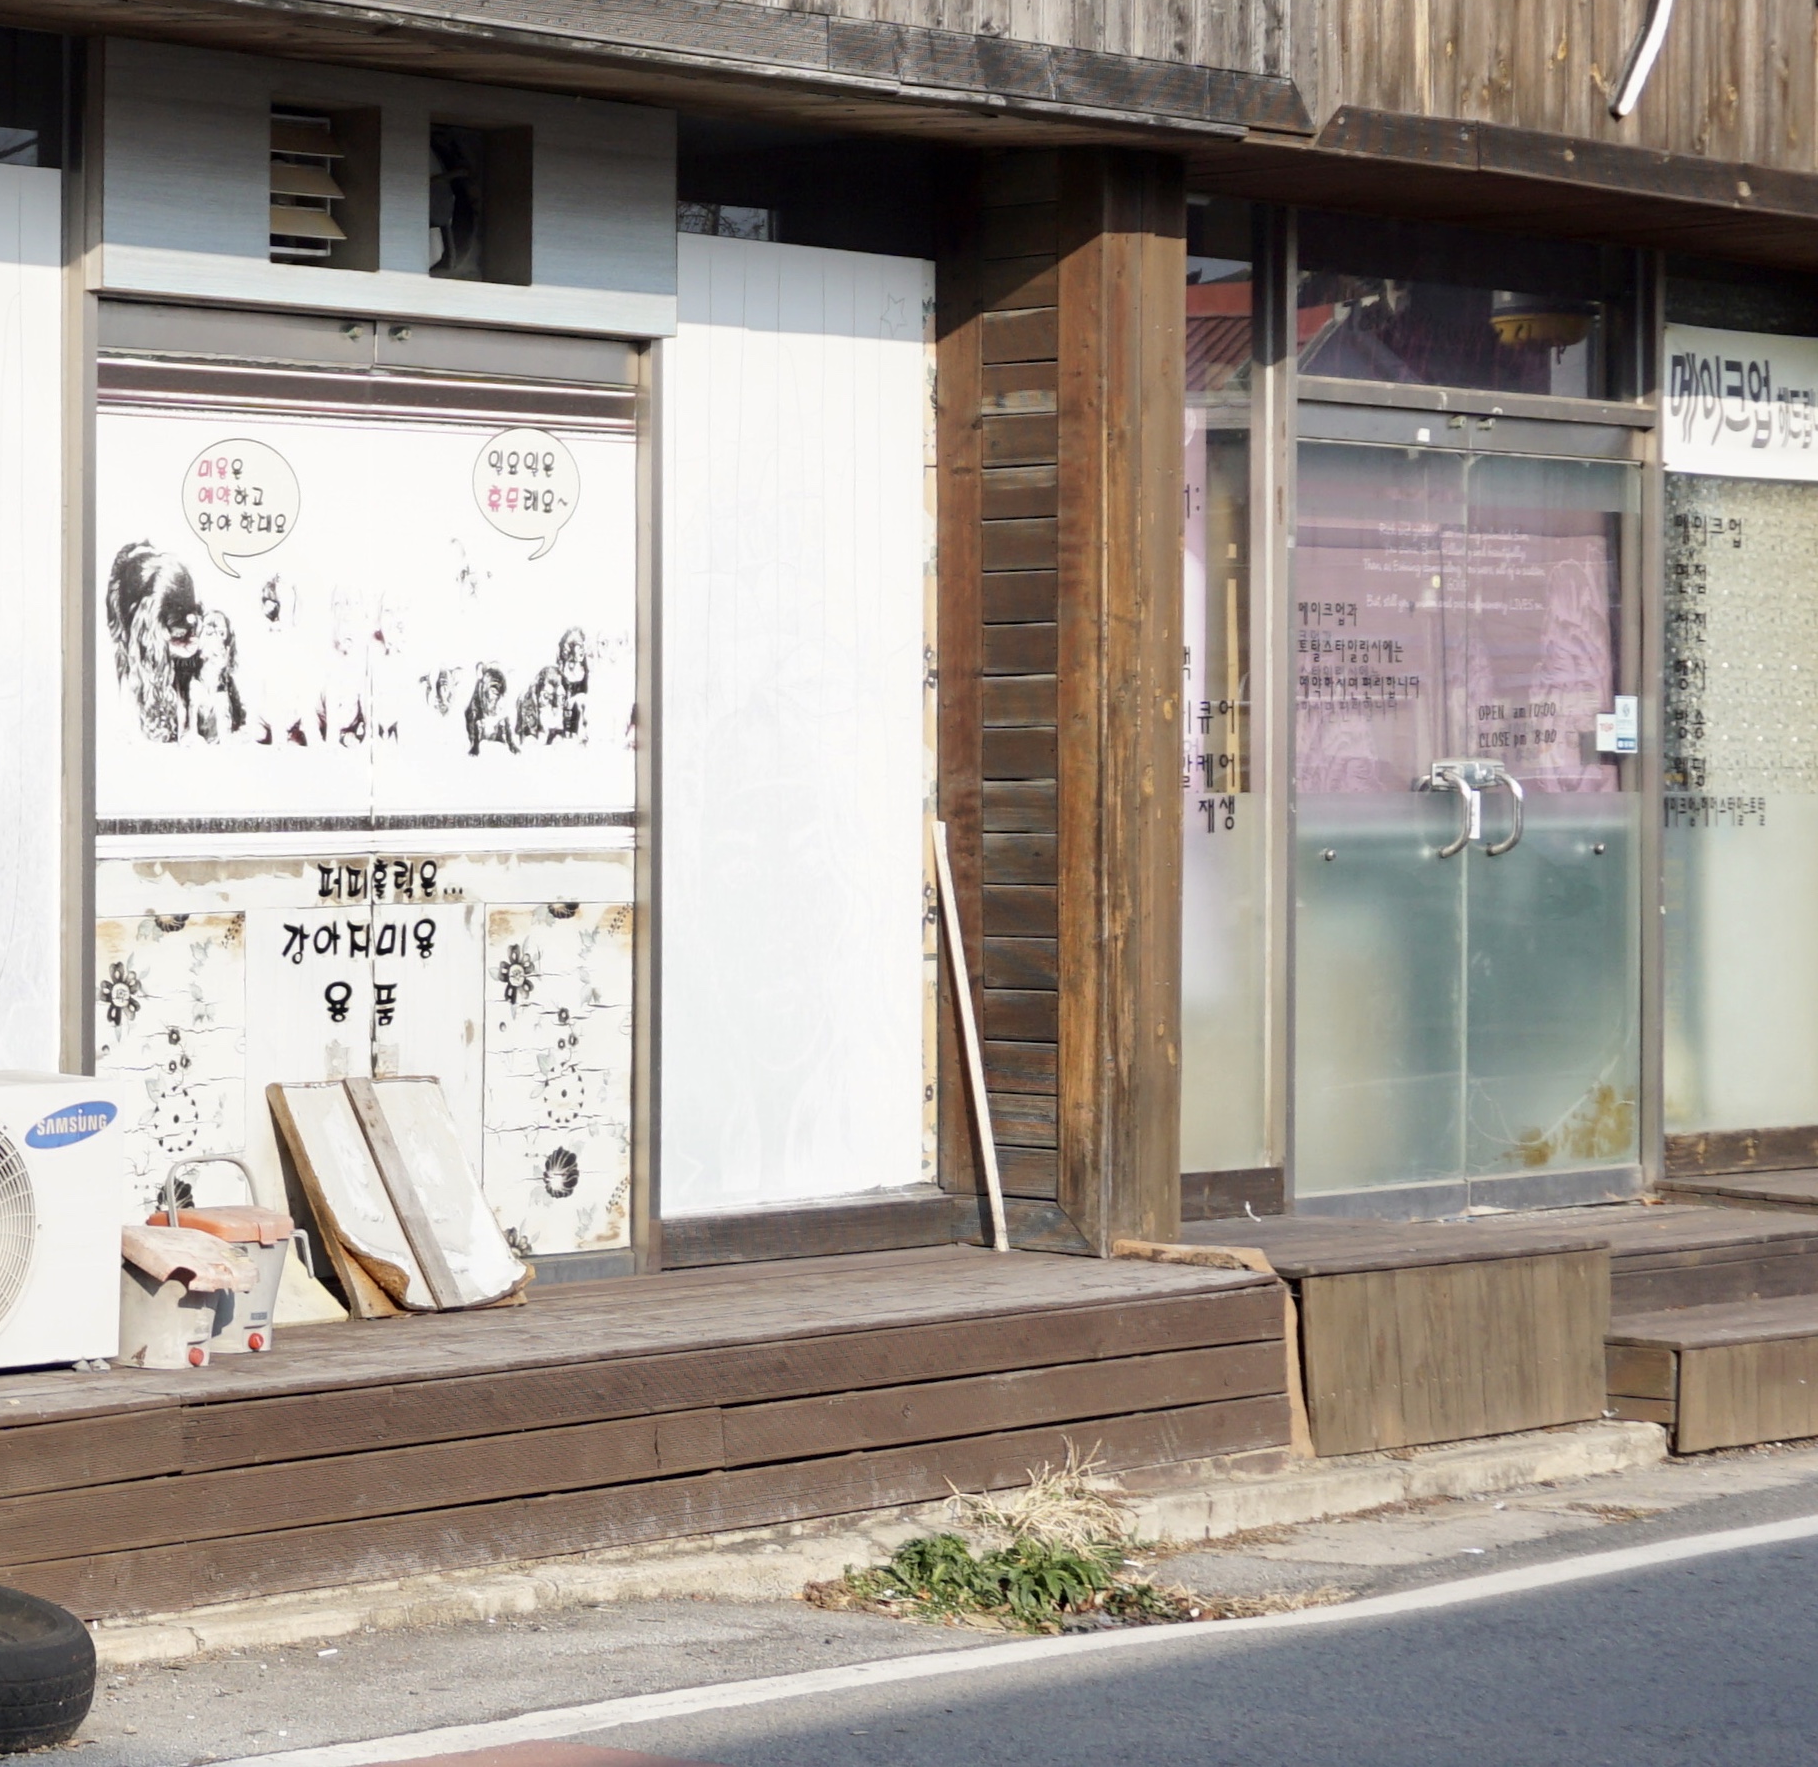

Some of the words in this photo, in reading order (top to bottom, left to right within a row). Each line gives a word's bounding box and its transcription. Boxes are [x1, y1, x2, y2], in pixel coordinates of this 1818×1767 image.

[1671, 352, 1772, 448] 메이크업
[198, 457, 243, 480] 미용은
[488, 449, 555, 478] 일요일은
[198, 485, 263, 506] 예약하고
[240, 511, 286, 534] 한대요
[1298, 602, 1357, 626] 메이크업과
[1478, 705, 1505, 721] OPEN
[1479, 731, 1510, 748] CLOSE
[1198, 795, 1235, 833] 재생
[36, 1113, 107, 1136] SAMSUNG
